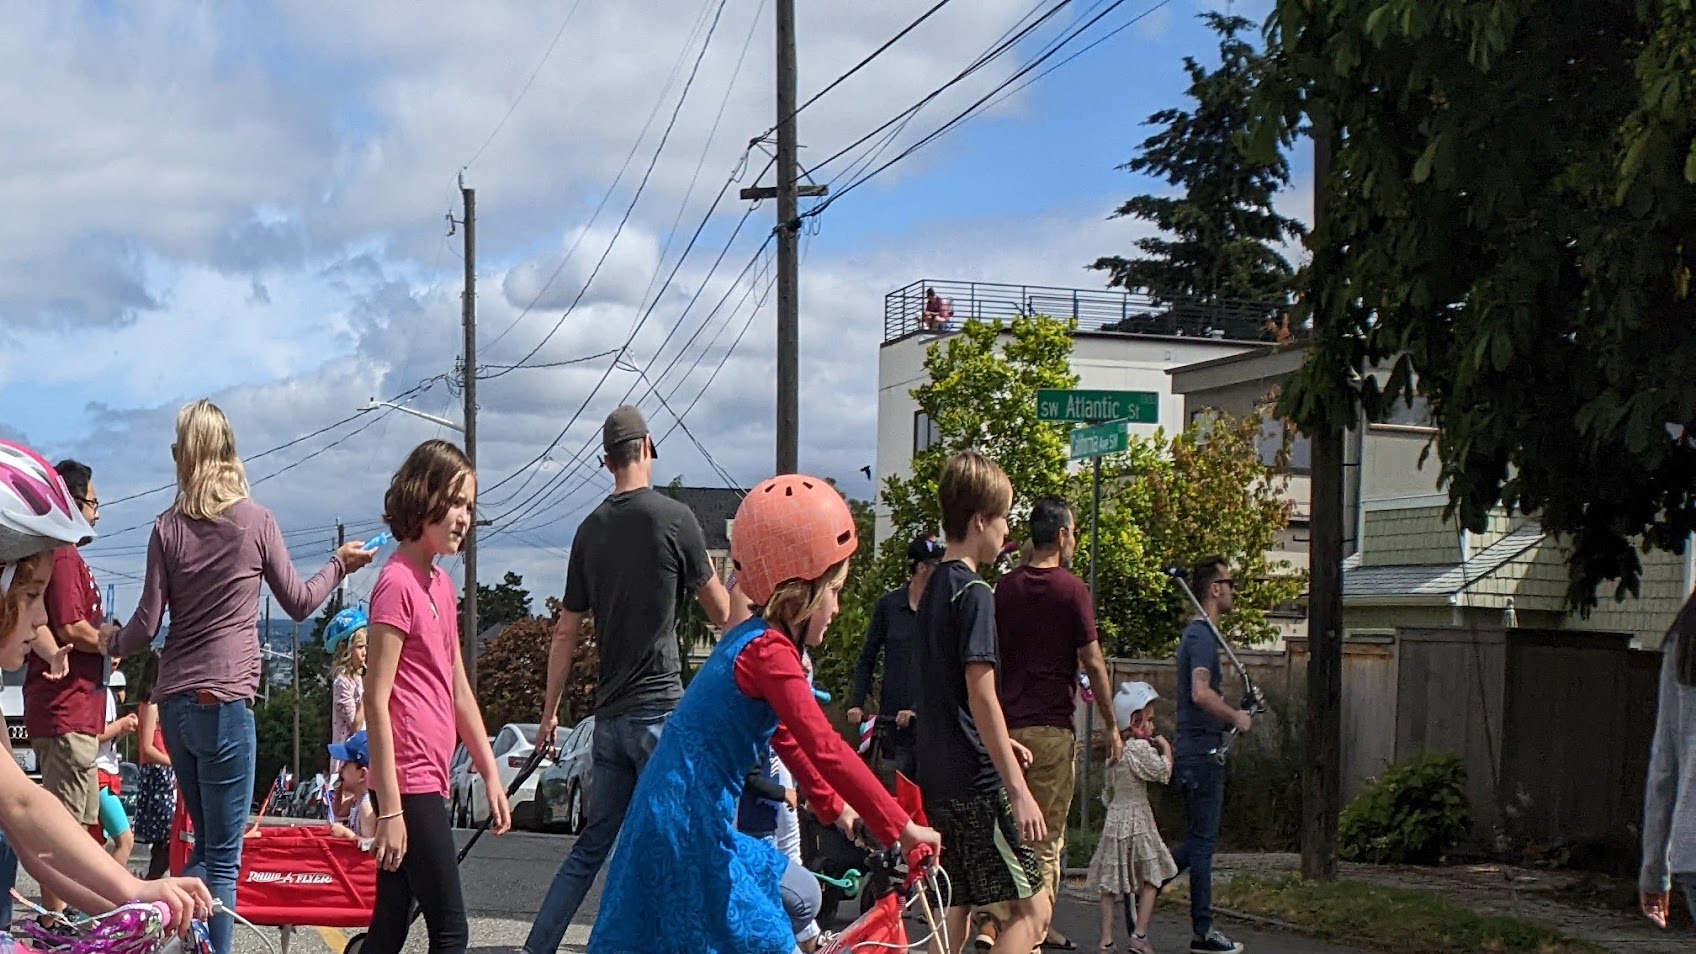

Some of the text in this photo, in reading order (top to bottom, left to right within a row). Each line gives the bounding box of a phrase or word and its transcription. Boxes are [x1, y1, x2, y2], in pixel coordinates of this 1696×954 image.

[1040, 401, 1059, 417] SW
[1065, 394, 1121, 419] Atlantic
[1127, 403, 1140, 420] St
